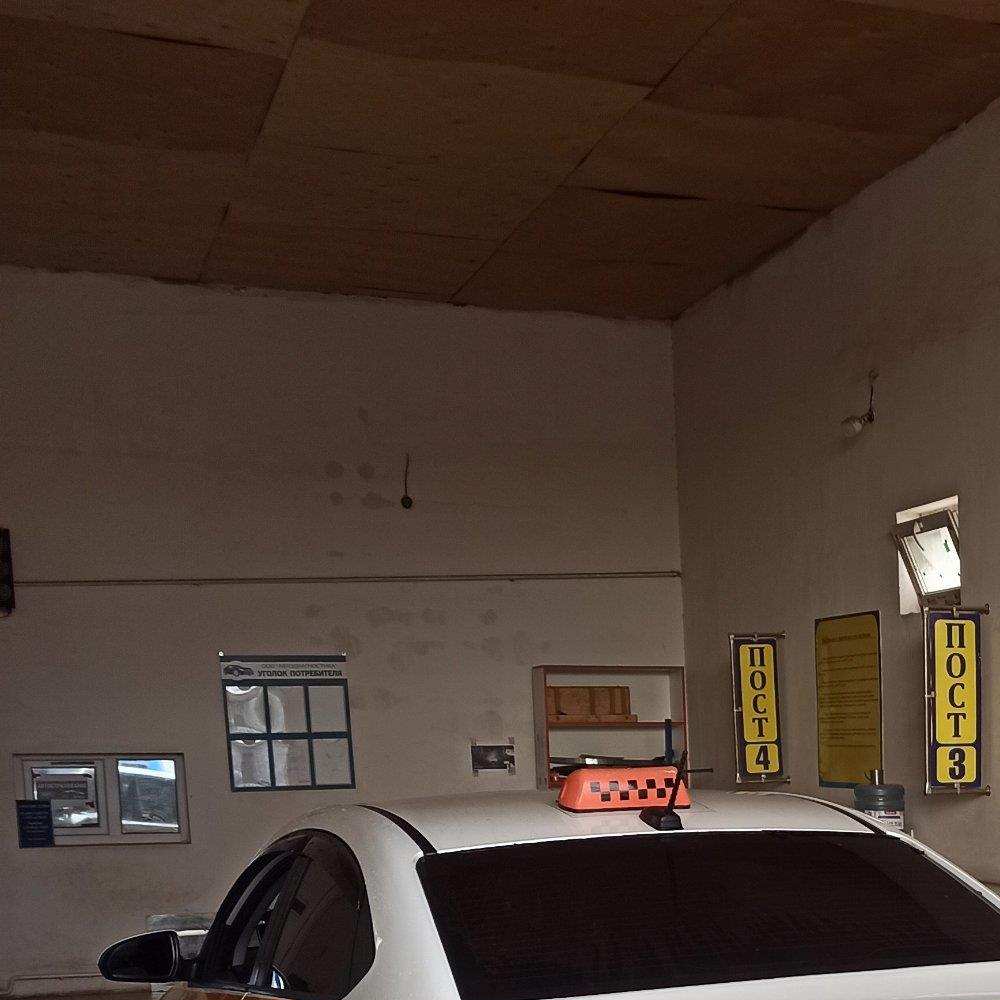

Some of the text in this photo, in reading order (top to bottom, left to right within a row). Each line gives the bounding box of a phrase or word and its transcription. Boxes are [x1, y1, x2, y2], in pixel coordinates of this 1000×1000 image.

[289, 669, 343, 677] ПОТРЕБИТЕЛЯ
[945, 622, 967, 738] ПОСТ
[747, 646, 769, 738] ПОСТ
[755, 745, 771, 771] 4
[948, 747, 966, 780] 3
